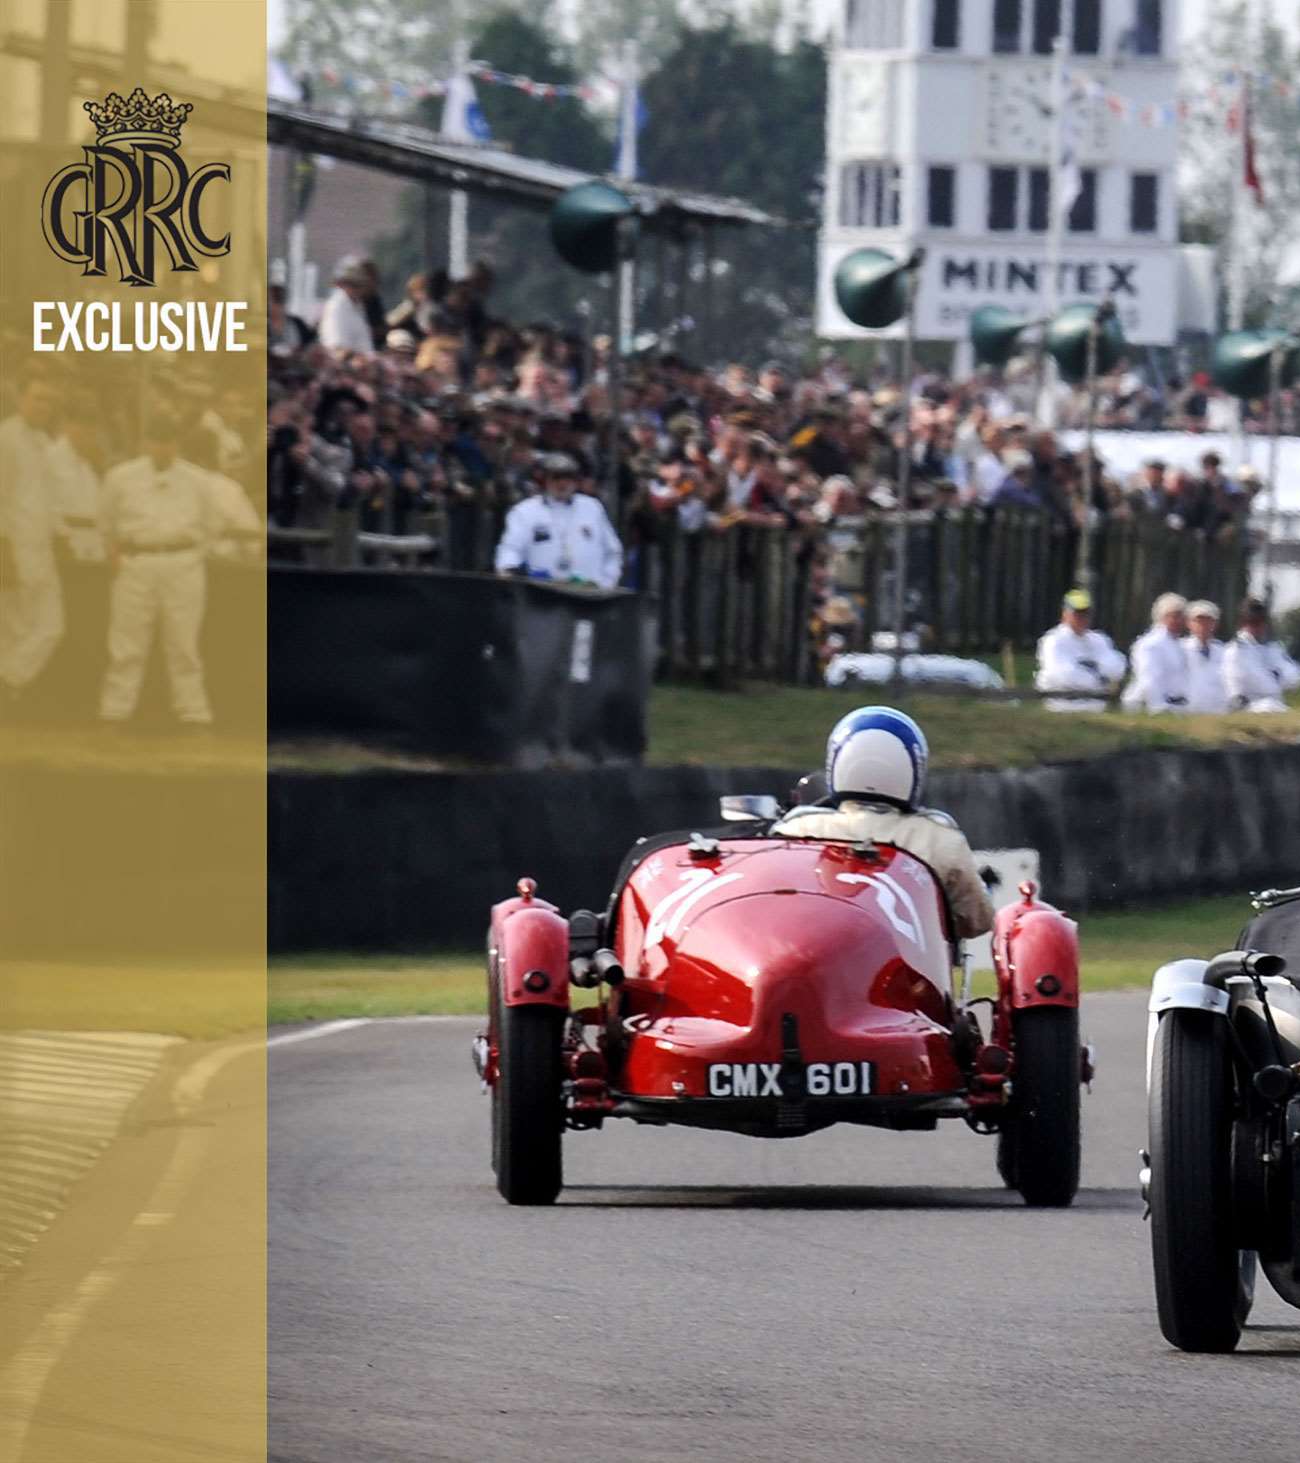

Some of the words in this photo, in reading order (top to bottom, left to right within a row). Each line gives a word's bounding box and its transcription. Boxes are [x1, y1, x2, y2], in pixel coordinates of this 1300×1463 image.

[943, 257, 1137, 296] MINTEX
[709, 1063, 784, 1097] CMX
[807, 1062, 870, 1095] 601
